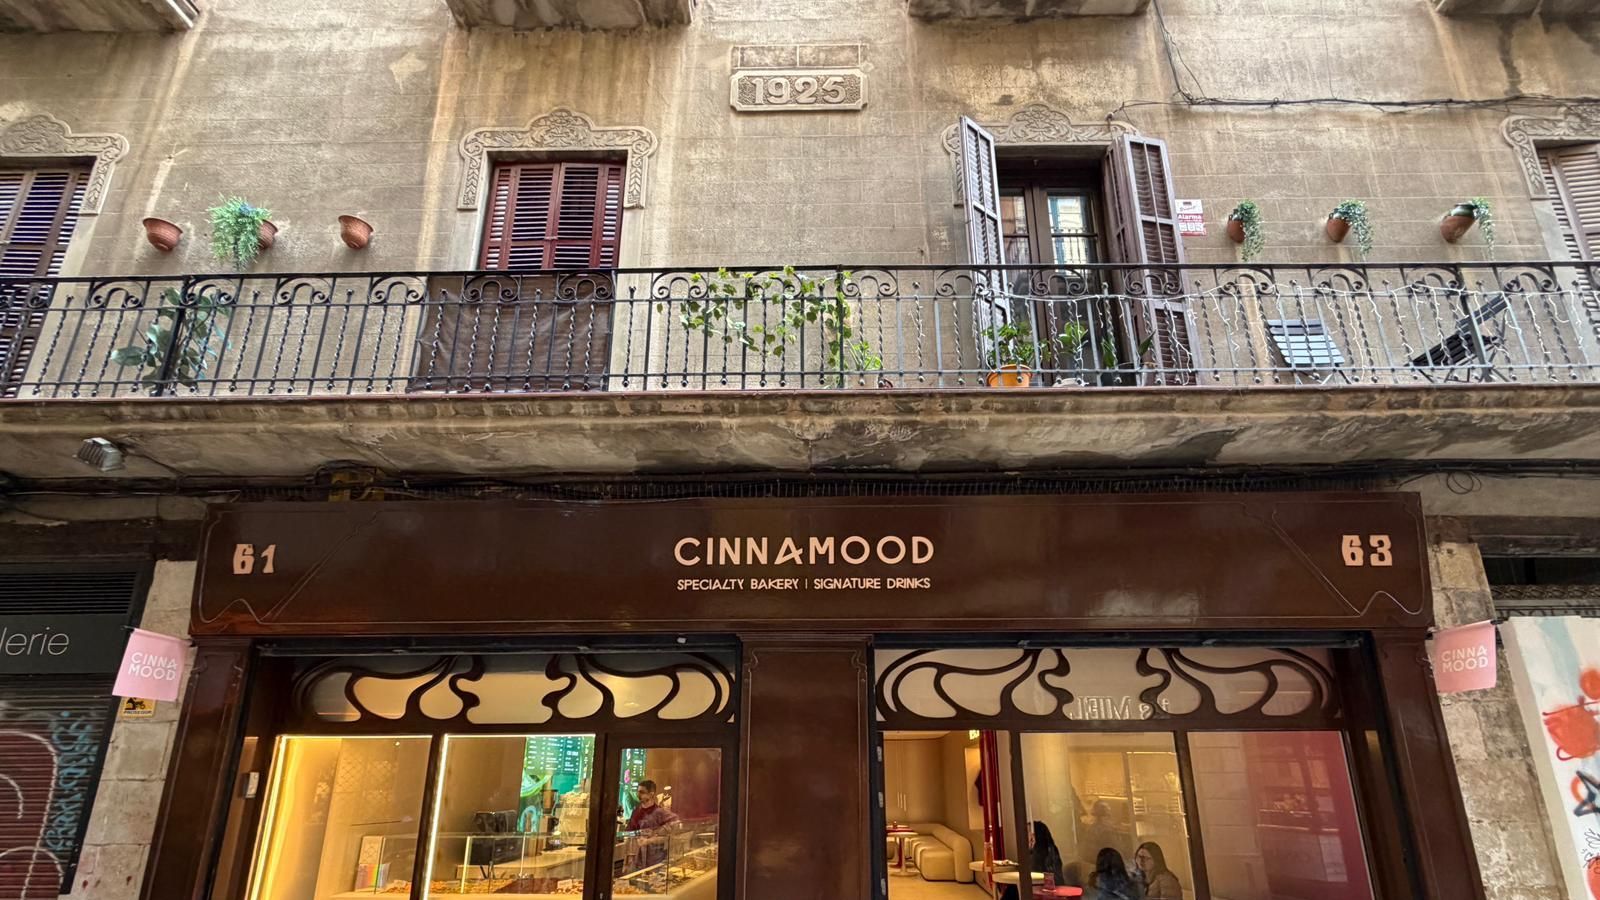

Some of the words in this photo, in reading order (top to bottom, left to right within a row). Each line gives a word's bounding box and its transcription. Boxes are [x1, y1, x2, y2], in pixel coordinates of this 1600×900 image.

[750, 76, 847, 105] 1925
[233, 543, 276, 575] 61
[674, 535, 934, 566] CINNAMOOD
[1341, 534, 1393, 567] 63
[676, 578, 745, 591] SPECIALTY
[750, 578, 799, 590] BAKERY
[813, 577, 881, 590] SIGNATURE
[886, 577, 931, 589] DRINKS
[0, 626, 69, 655] lerie
[131, 652, 178, 669] CINNA
[1441, 645, 1488, 662] CINNA
[1442, 656, 1489, 673] MOOD
[127, 663, 176, 680] MOOD
